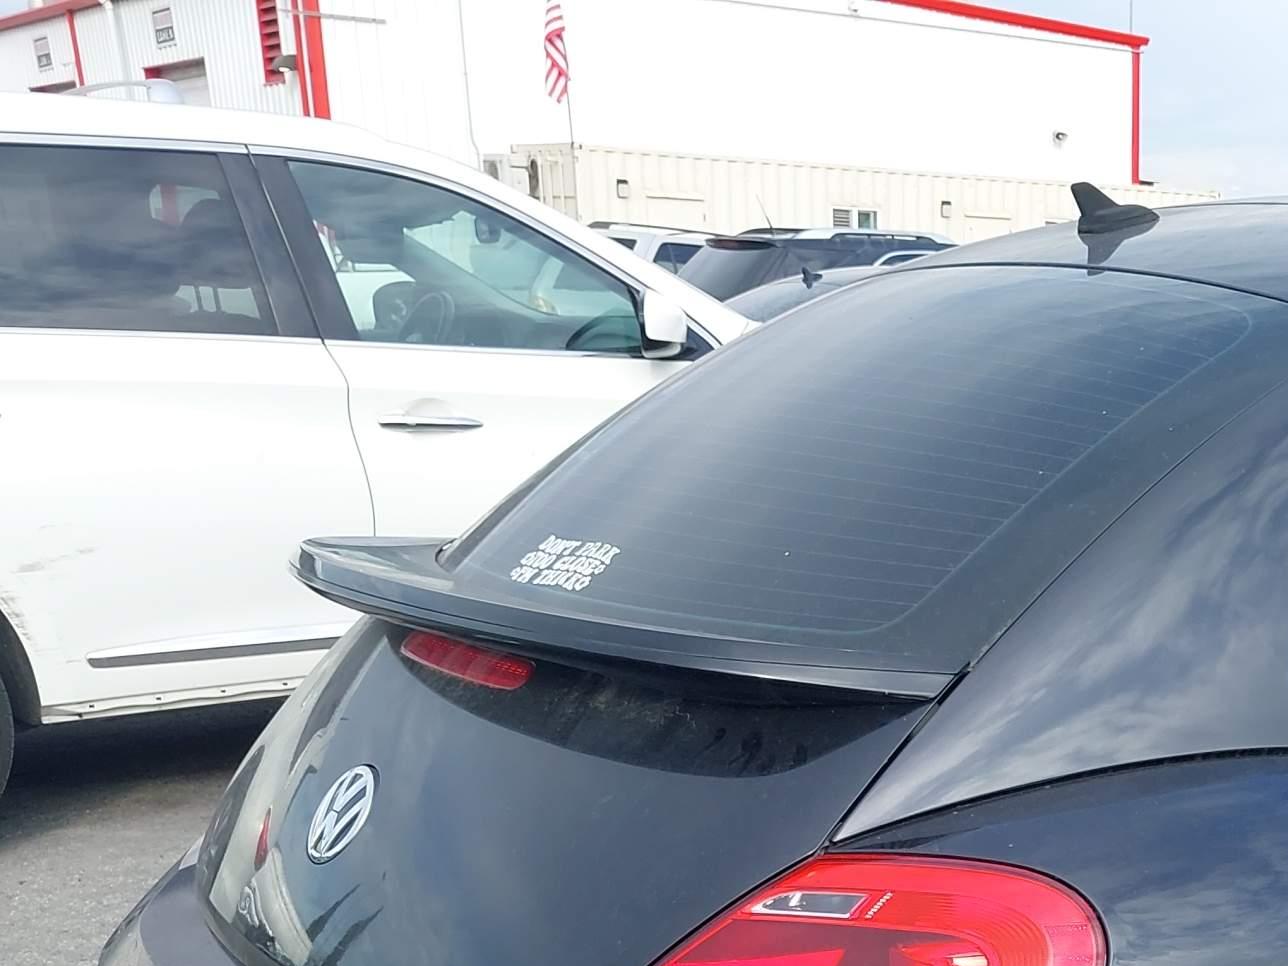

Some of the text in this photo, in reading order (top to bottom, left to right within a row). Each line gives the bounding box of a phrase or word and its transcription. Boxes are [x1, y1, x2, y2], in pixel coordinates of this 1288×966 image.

[538, 534, 621, 565] DON'T PARK
[553, 556, 601, 576] CLOSE
[533, 569, 583, 591] THICK
